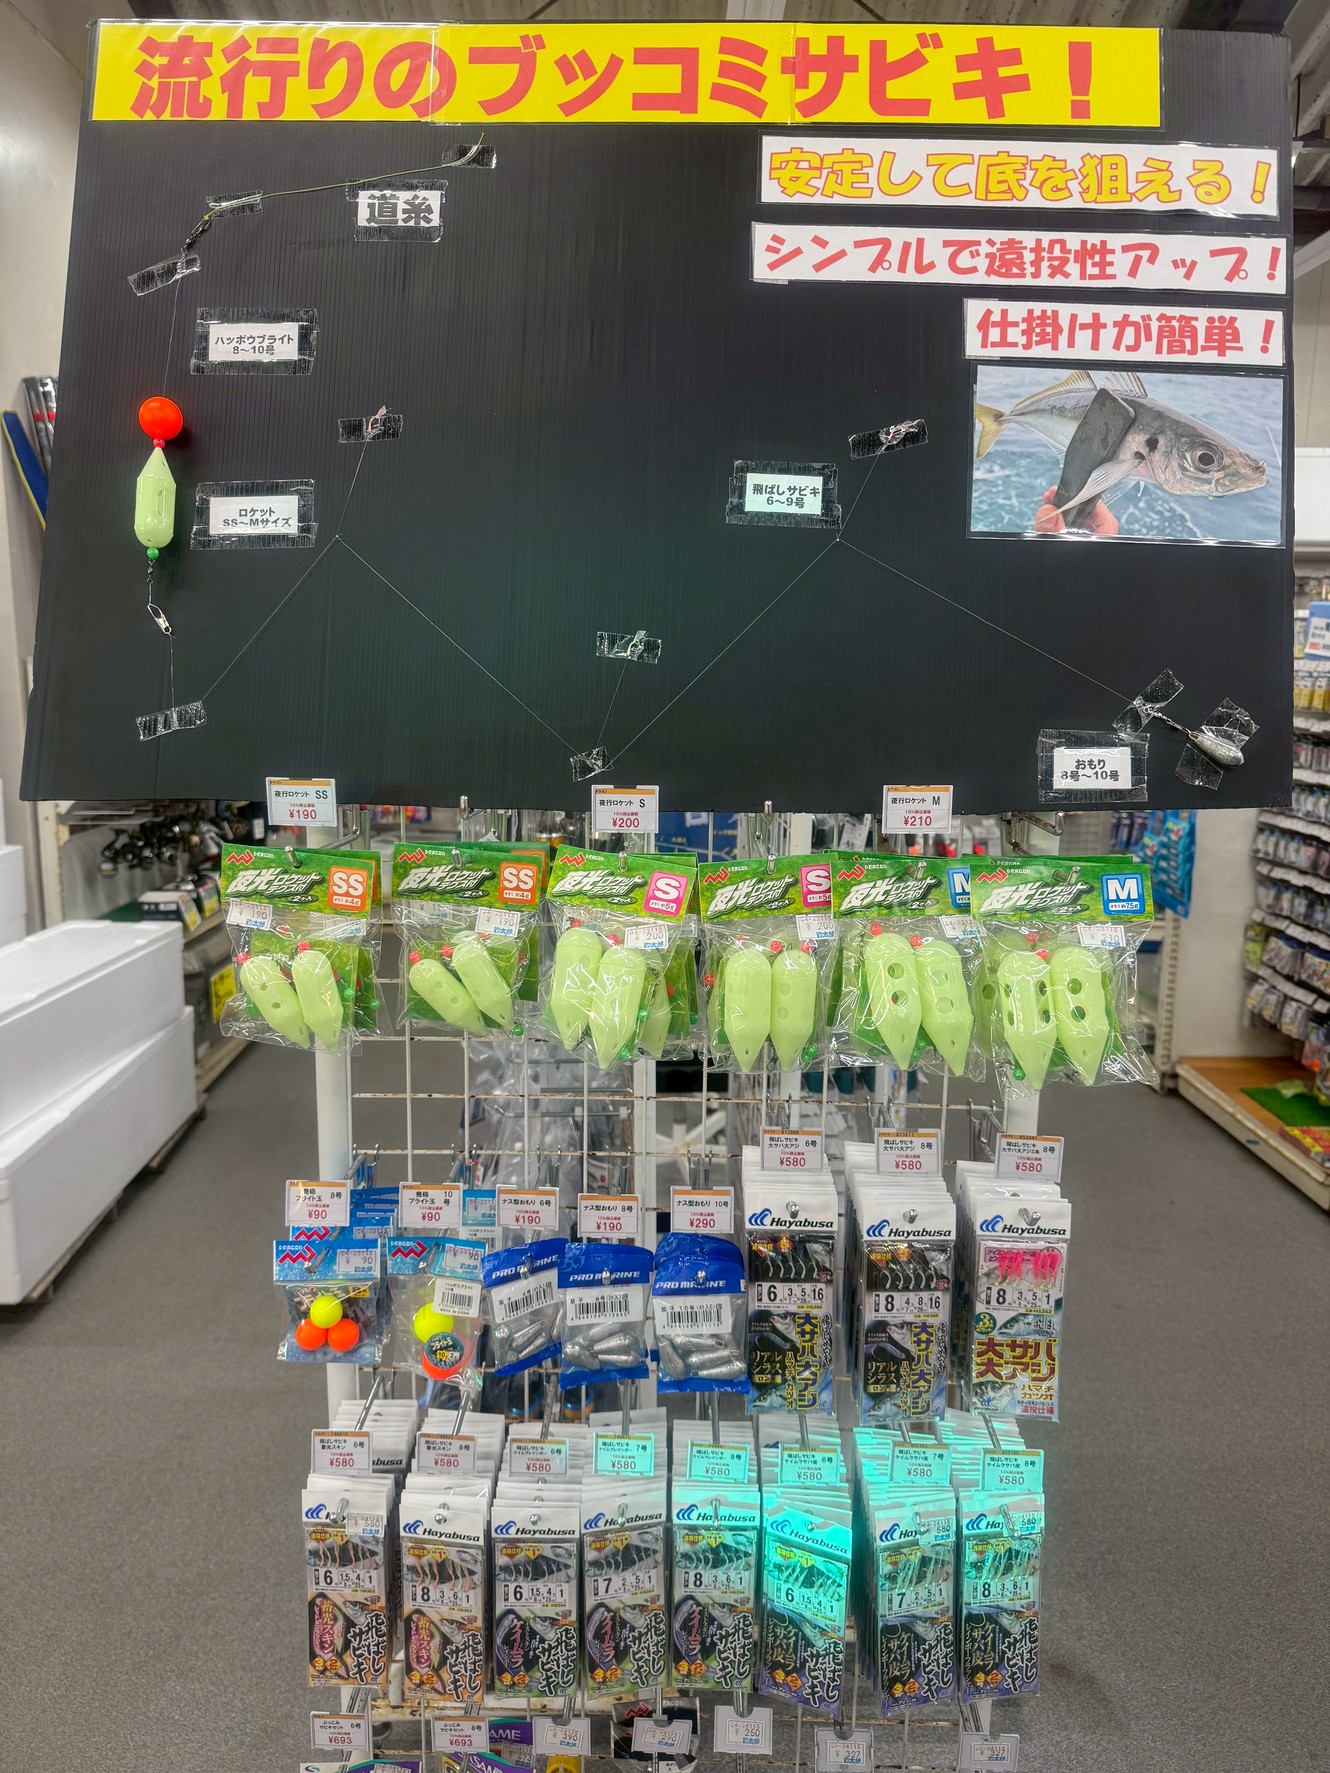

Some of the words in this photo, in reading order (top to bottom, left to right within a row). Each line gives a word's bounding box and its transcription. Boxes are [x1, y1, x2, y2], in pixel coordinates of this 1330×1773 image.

[130, 33, 1092, 120] 流行りのブッコミサビキ！
[769, 147, 1272, 205] 安定して底を狙える！
[367, 193, 433, 225] 道糸
[762, 233, 1283, 283] シンプルで遠投性アップ！
[976, 308, 1276, 357] 仕掛けが簡単！
[215, 334, 294, 345] ハッポウブライト
[753, 484, 820, 496] 飛ばしサビキ
[239, 507, 275, 517] ロケット
[1075, 759, 1106, 769] おもり
[316, 790, 328, 799] SS
[640, 799, 646, 808] S
[933, 796, 940, 805] M
[289, 809, 317, 819] ¥190
[612, 818, 639, 828] ¥200
[904, 816, 932, 826] ¥210
[332, 872, 364, 896] SS
[503, 868, 534, 890] SS
[806, 870, 830, 891] S
[953, 873, 970, 893] M
[653, 878, 681, 899] S
[1108, 879, 1138, 900] M
[780, 1157, 805, 1167] ¥580
[895, 1160, 921, 1170] ¥580
[1016, 1162, 1042, 1172] ¥580
[308, 1210, 327, 1219] ¥90
[421, 1212, 440, 1221] ¥90
[515, 1215, 541, 1224] ¥190
[596, 1222, 622, 1231] ¥190
[690, 1218, 715, 1228] ¥290
[770, 1218, 833, 1228] Hayabusa
[888, 1228, 951, 1238] Hayabusa
[1001, 1224, 1066, 1235] Hayabusa
[492, 1267, 516, 1279] PRO
[570, 1273, 593, 1281] PRO
[977, 1337, 1056, 1361] 大サバ
[753, 1351, 782, 1361] リアル
[753, 1364, 782, 1374] シラス
[868, 1362, 897, 1372] リアル
[976, 1360, 1056, 1382] 大アジ
[868, 1374, 897, 1384] シラス
[330, 1458, 354, 1467] ¥580
[434, 1458, 459, 1467] ¥580
[526, 1463, 551, 1472] ¥580
[612, 1461, 636, 1469] ¥580
[705, 1467, 730, 1476] ¥580
[797, 1472, 822, 1480] ¥580
[907, 1468, 932, 1477] ¥580
[999, 1476, 1024, 1484] ¥580
[697, 1513, 755, 1522] Haabusa
[423, 1528, 480, 1542] Hayabusa
[515, 1528, 576, 1536] Hayabusa
[790, 1530, 847, 1554] Hayabusa
[328, 1736, 352, 1744] ¥693
[450, 1738, 472, 1746] ¥693
